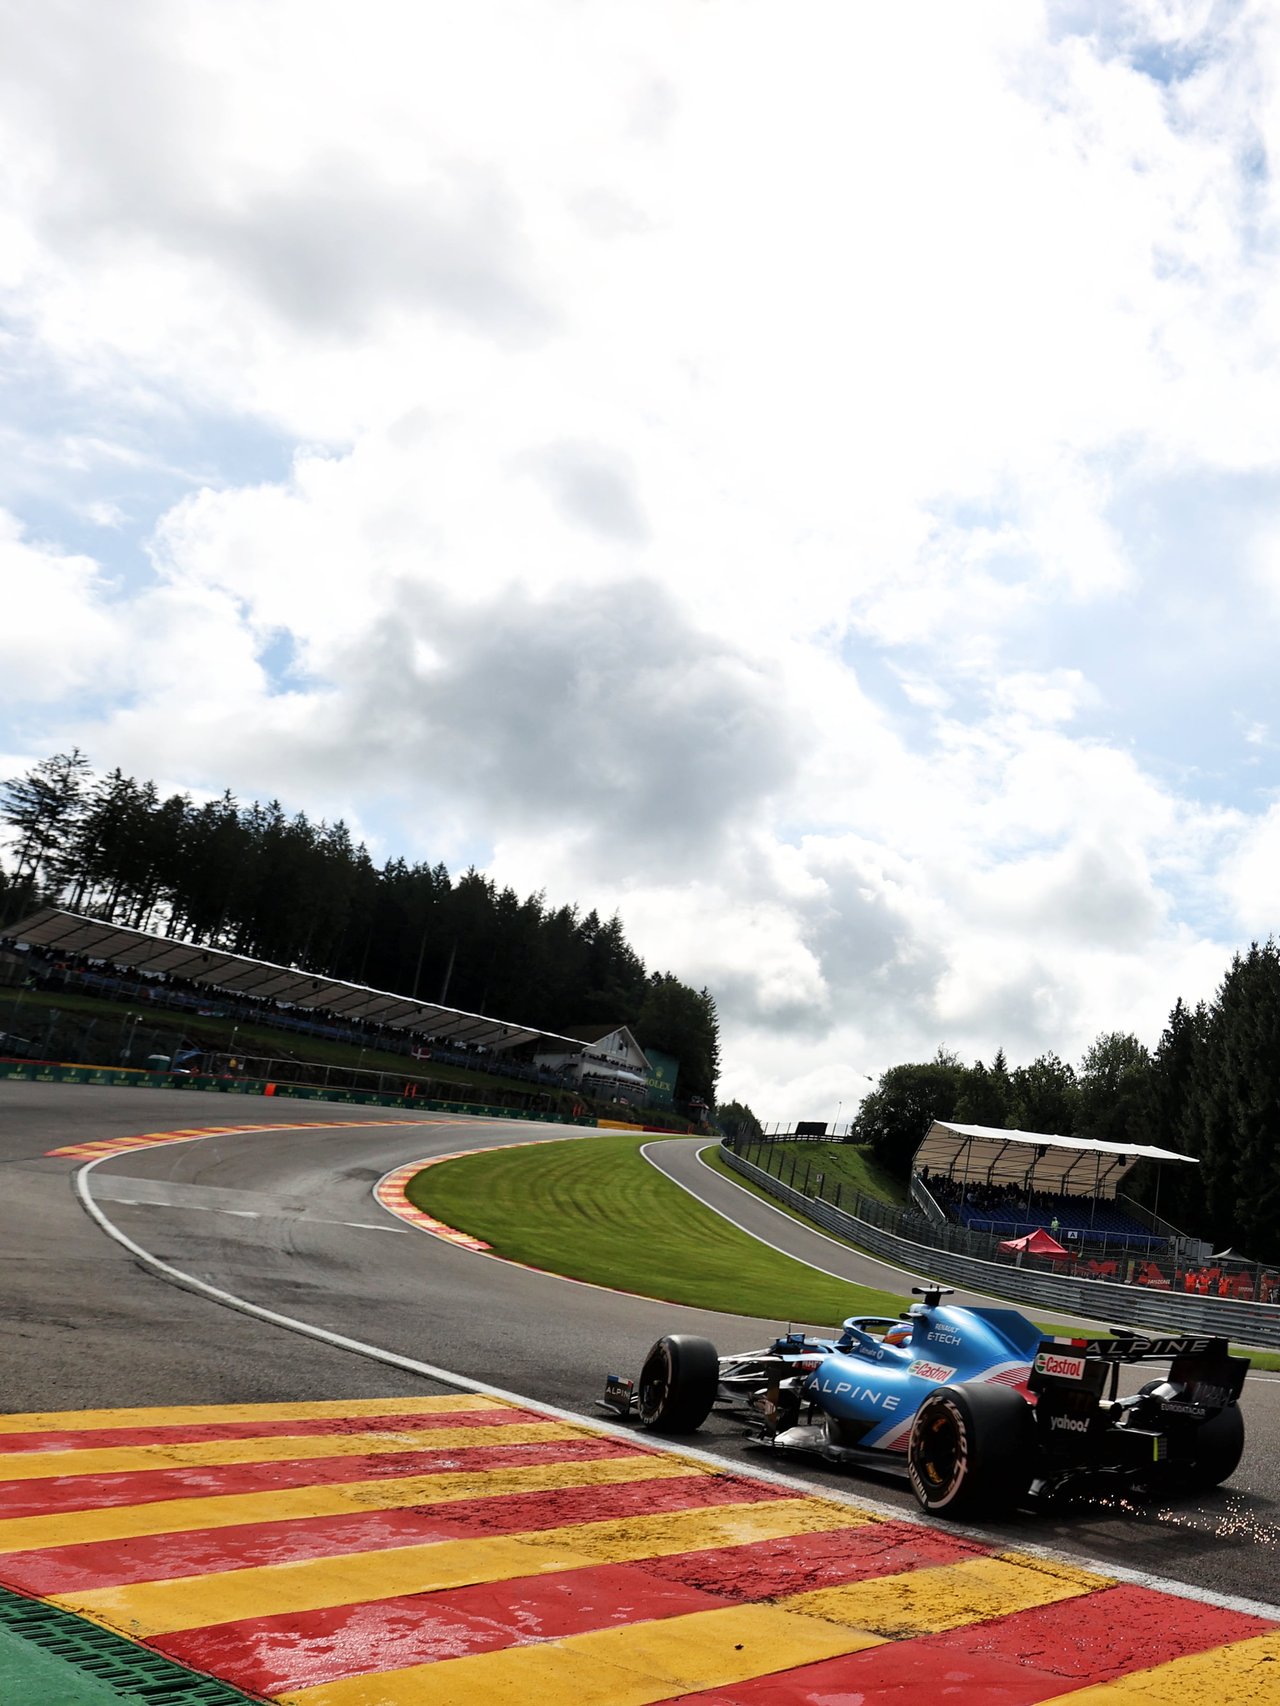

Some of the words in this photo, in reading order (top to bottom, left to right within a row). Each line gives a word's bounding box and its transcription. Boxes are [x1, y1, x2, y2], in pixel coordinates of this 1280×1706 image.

[935, 1323, 960, 1333] RENAULT
[927, 1333, 962, 1346] E-TECH
[1086, 1340, 1211, 1355] ALPINE
[916, 1363, 953, 1382] Castrol
[1045, 1356, 1082, 1377] Castrol
[808, 1377, 901, 1411] ALPINE
[1050, 1414, 1090, 1433] yahoo!
